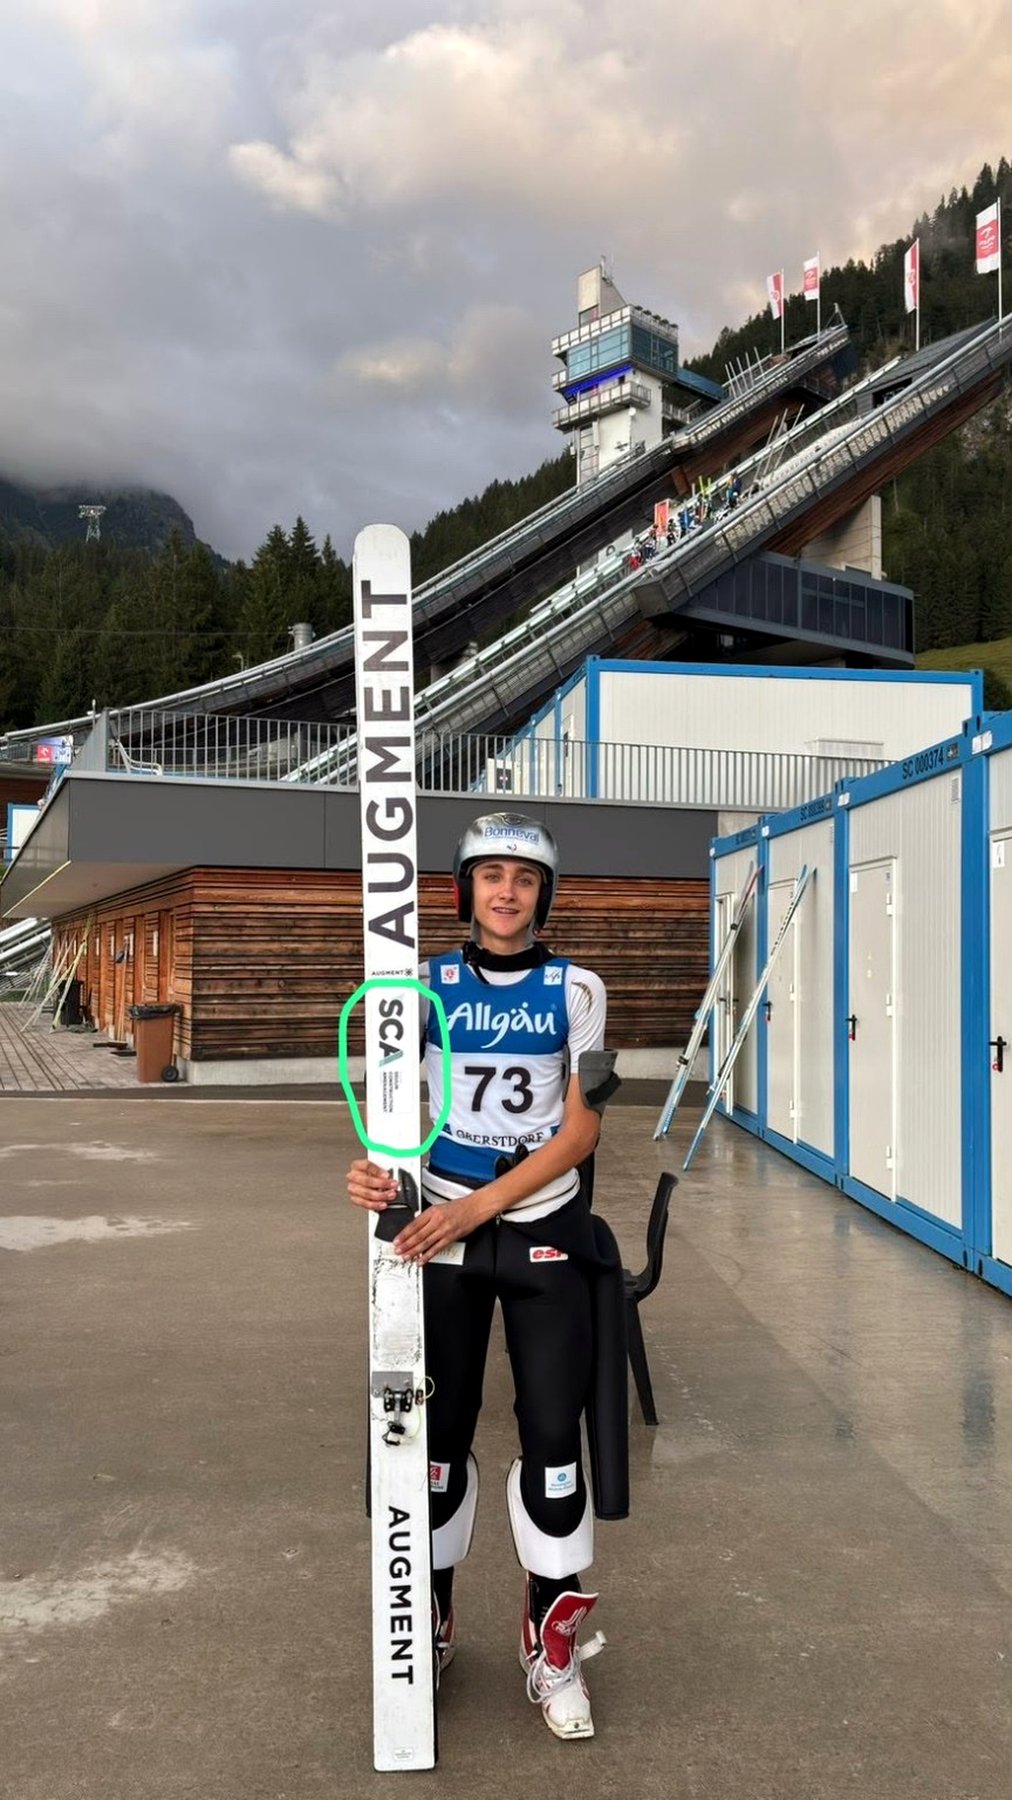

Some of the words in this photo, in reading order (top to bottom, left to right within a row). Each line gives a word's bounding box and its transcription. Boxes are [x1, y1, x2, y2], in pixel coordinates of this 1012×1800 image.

[361, 579, 416, 950] AUGMENT
[902, 759, 914, 780] SC
[914, 746, 944, 775] 000374
[484, 825, 540, 843] Bonneval
[371, 969, 404, 977] AUGMENT
[378, 998, 404, 1067] SCA
[446, 1001, 558, 1049] Allgäu
[464, 1065, 534, 1114] 73
[455, 1129, 545, 1147] OBERSTDORF
[388, 1505, 415, 1685] AUGMENT
